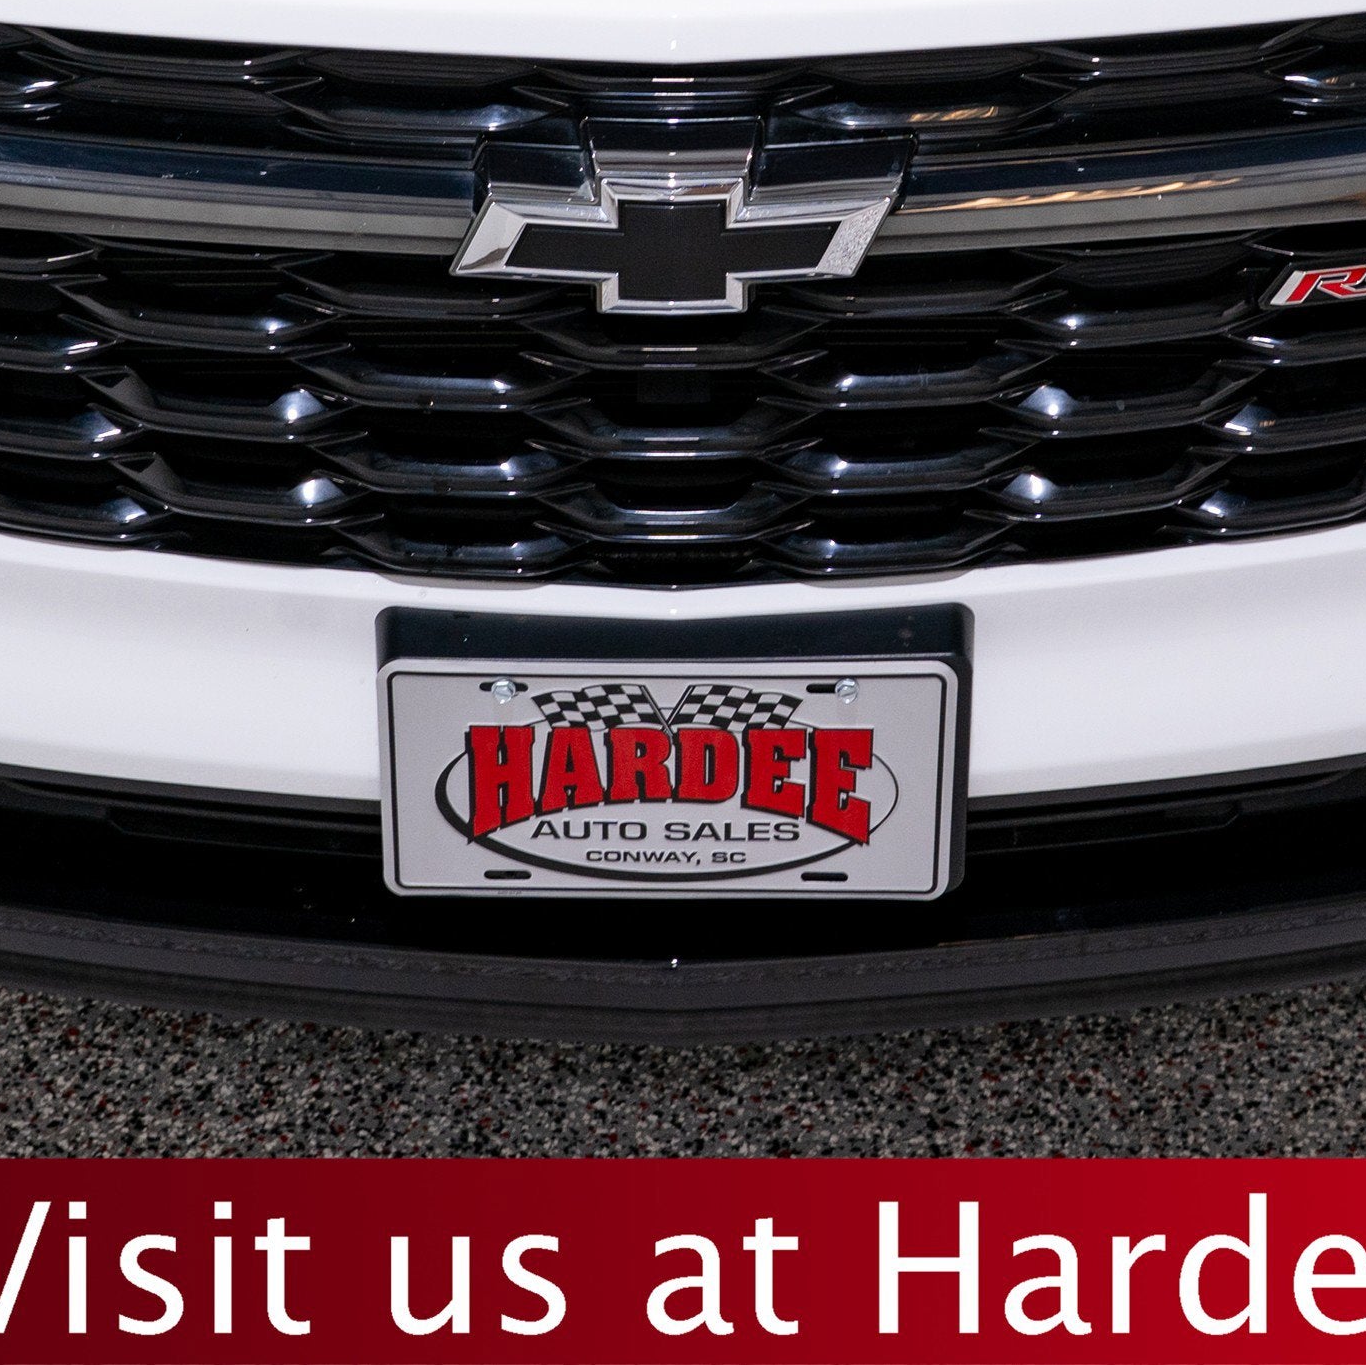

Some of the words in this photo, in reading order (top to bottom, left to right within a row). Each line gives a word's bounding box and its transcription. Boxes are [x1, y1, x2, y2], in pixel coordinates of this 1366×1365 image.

[465, 725, 875, 846] HARDEE
[530, 820, 647, 841] AUTO
[664, 821, 800, 842] SALES
[585, 850, 701, 865] CONWAY,
[711, 851, 747, 864] SC
